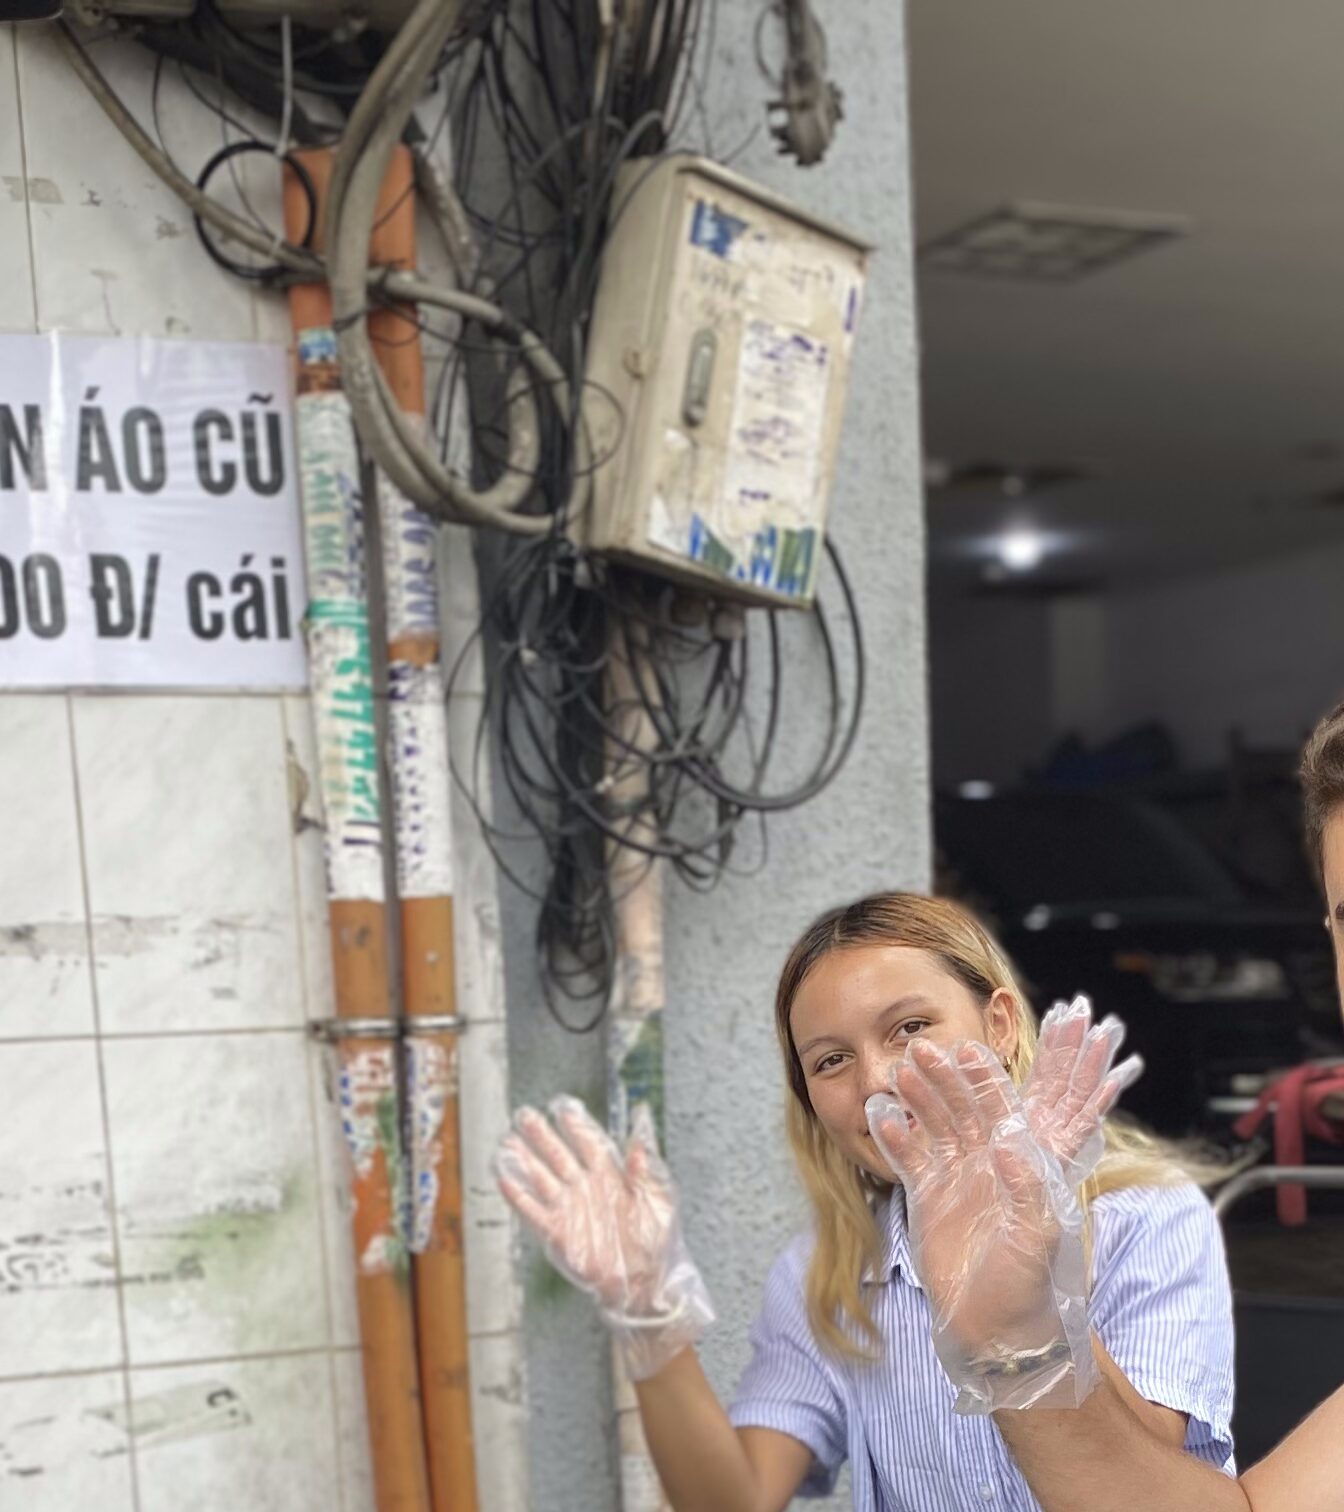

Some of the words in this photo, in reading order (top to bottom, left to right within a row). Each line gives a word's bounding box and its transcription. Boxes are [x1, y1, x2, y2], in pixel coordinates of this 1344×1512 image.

[76, 386, 166, 494] ÁO
[192, 392, 285, 497] CŨ
[89, 553, 160, 641] Đ/
[185, 553, 292, 642] cái
